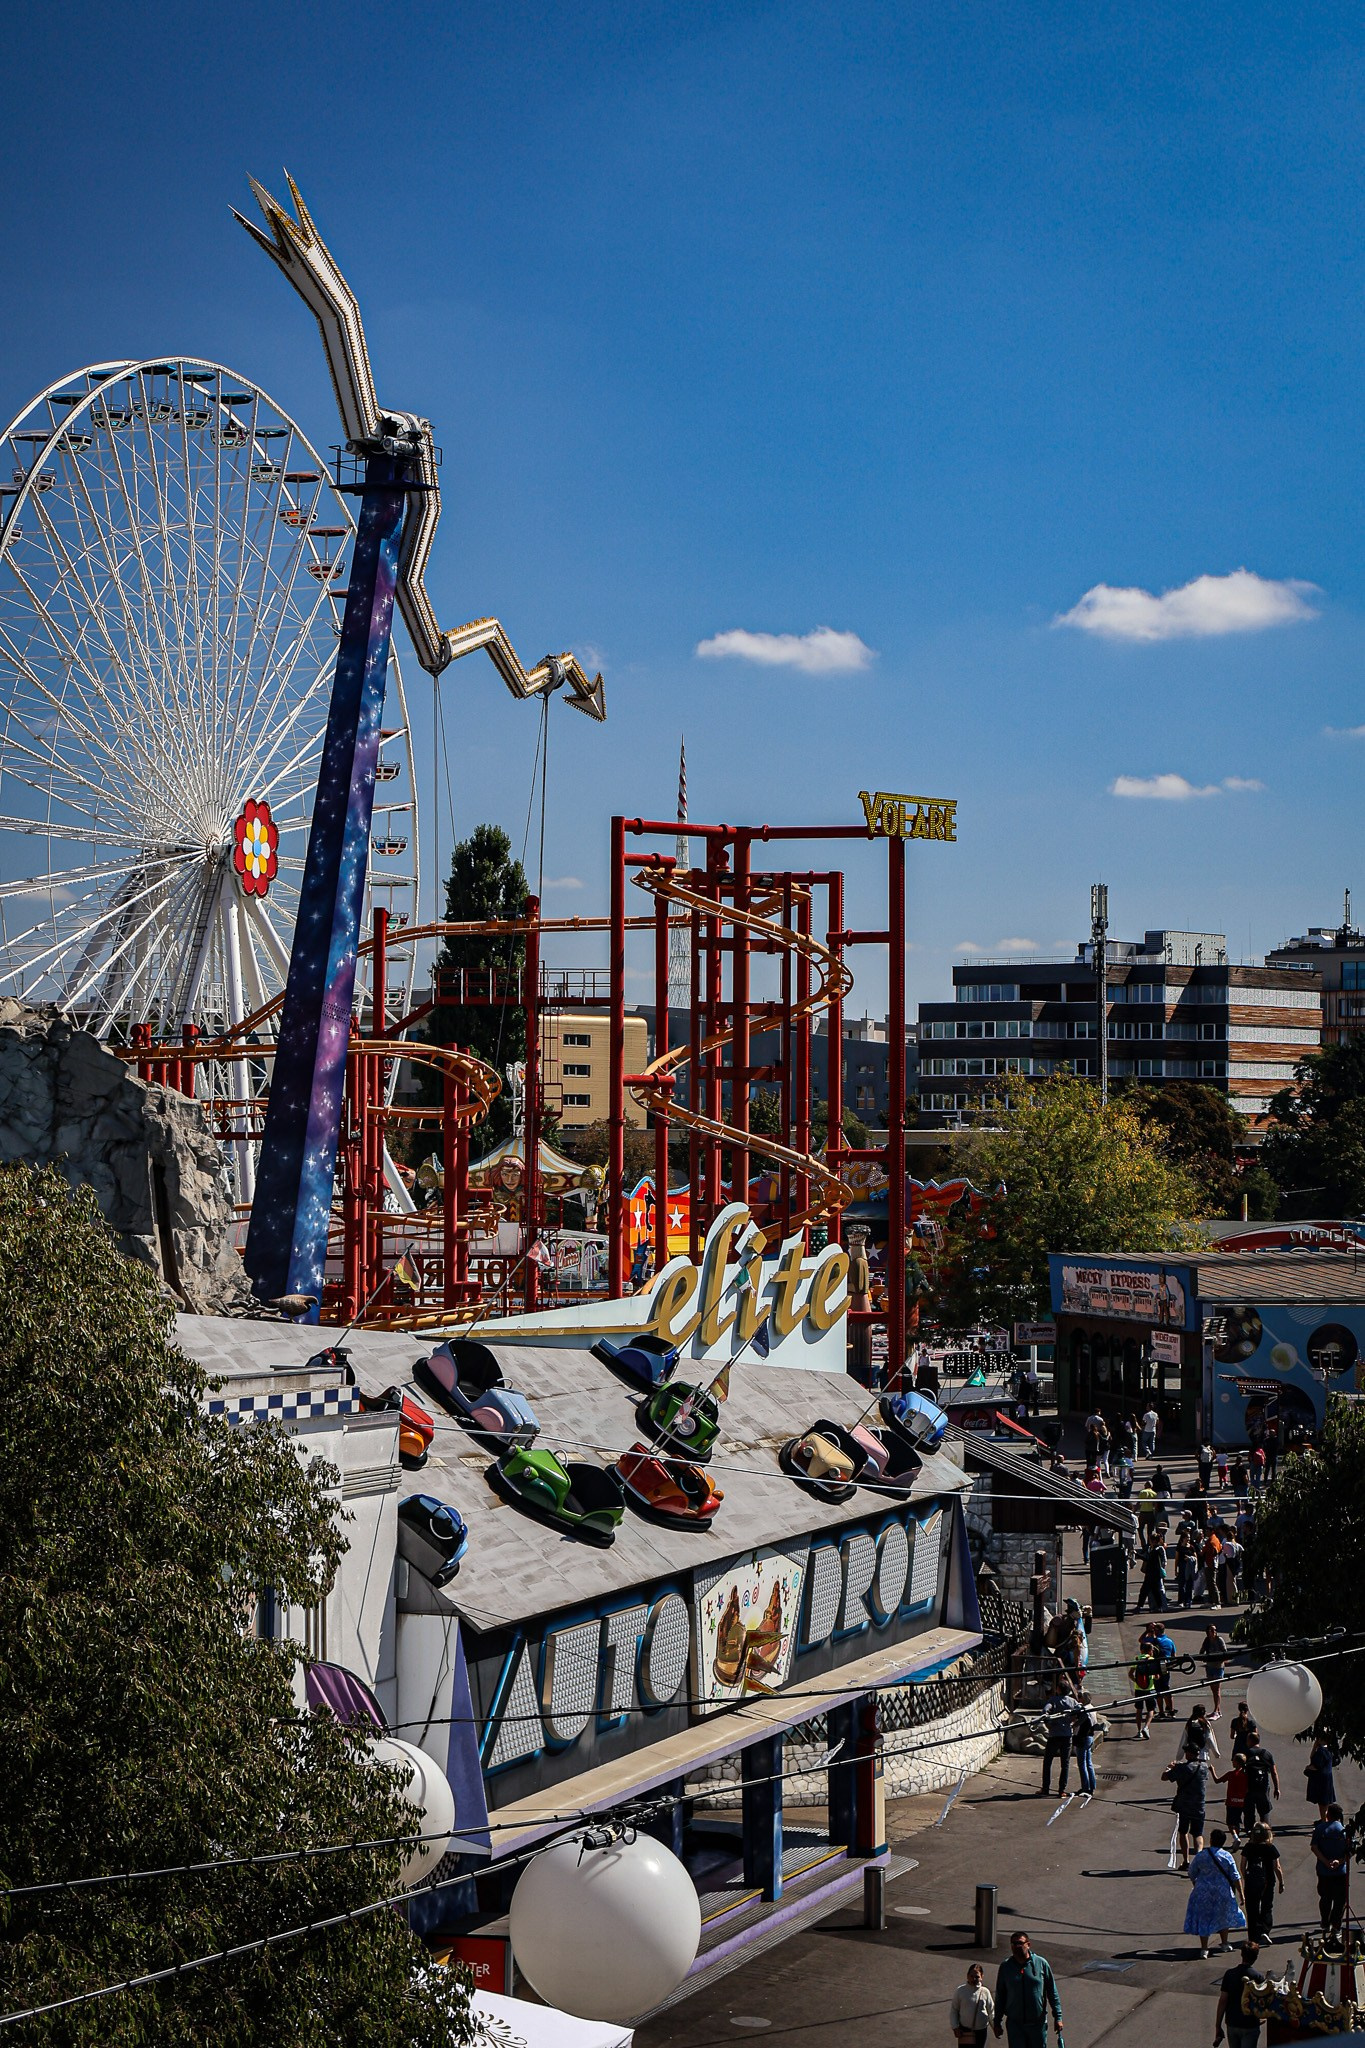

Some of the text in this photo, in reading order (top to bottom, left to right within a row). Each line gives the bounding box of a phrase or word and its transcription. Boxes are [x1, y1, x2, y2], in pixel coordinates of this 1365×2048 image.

[858, 791, 957, 841] VOLARE
[1290, 1229, 1356, 1243] SUPER
[655, 1211, 852, 1348] elite
[1076, 1270, 1151, 1290] MECKY EXPRESS
[480, 1509, 943, 1769] AUTO DROM
